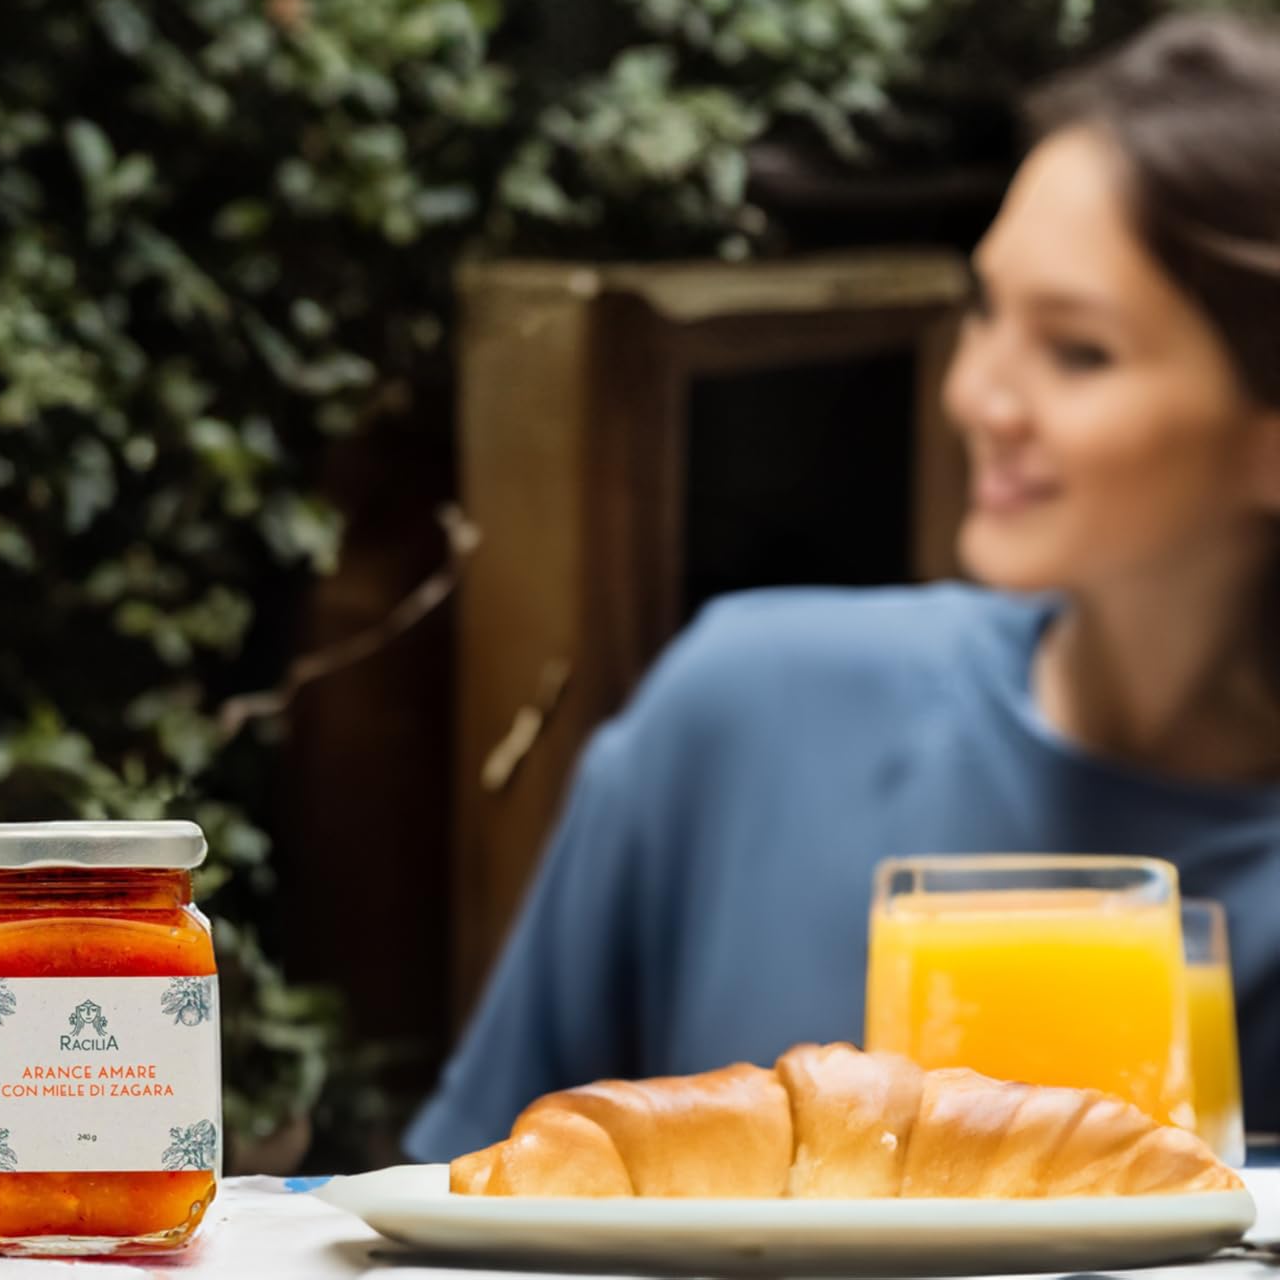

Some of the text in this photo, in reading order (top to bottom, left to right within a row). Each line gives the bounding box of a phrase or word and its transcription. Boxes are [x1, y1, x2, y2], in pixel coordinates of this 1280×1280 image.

[60, 1035, 119, 1051] RACILIA
[22, 1065, 156, 1079] ARANCE AMARE
[1, 1084, 174, 1097] CON MIELE DI ZAGARA
